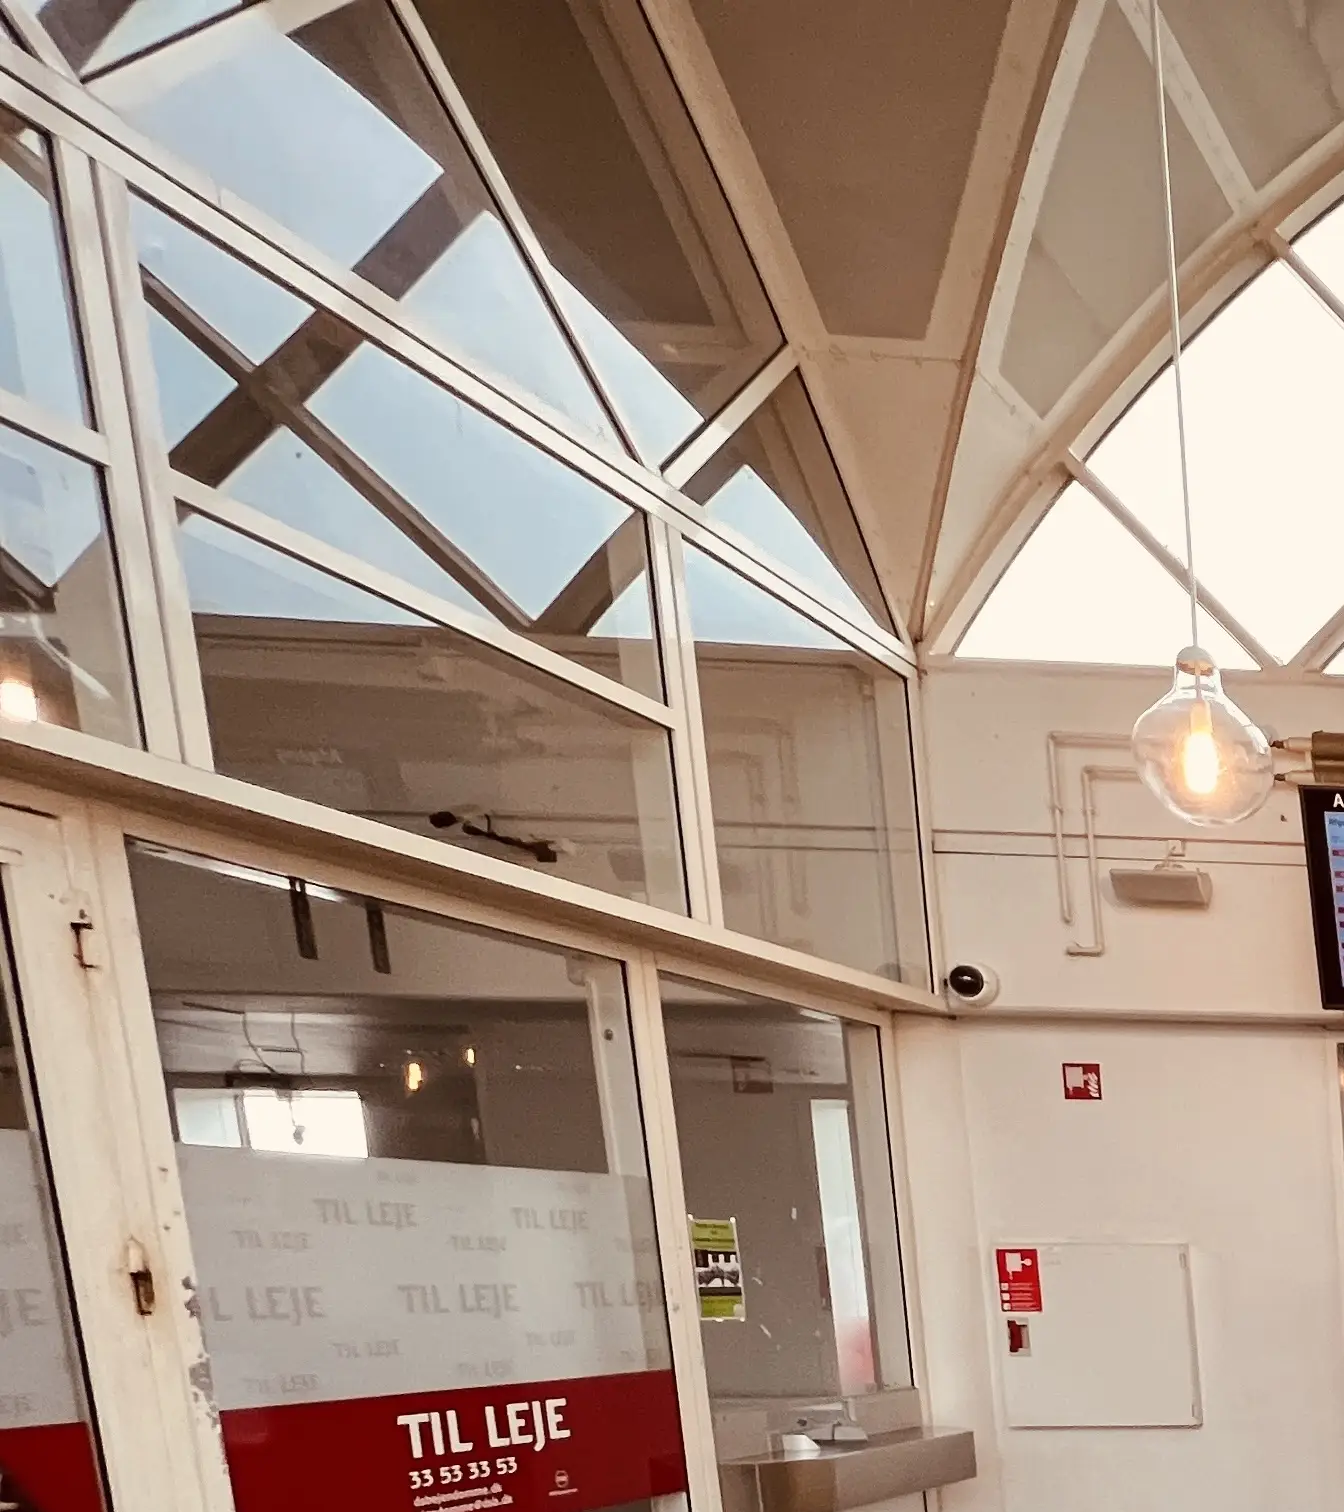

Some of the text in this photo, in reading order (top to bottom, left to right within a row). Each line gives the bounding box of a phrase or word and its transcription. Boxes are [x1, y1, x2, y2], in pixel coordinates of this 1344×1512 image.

[312, 1199, 420, 1231] TIL LEJE
[246, 1286, 330, 1327] LEJE
[397, 1283, 521, 1319] TIL LEJE
[397, 1398, 571, 1459] TIL LEJE
[409, 1456, 518, 1490] 33 53 33 53
